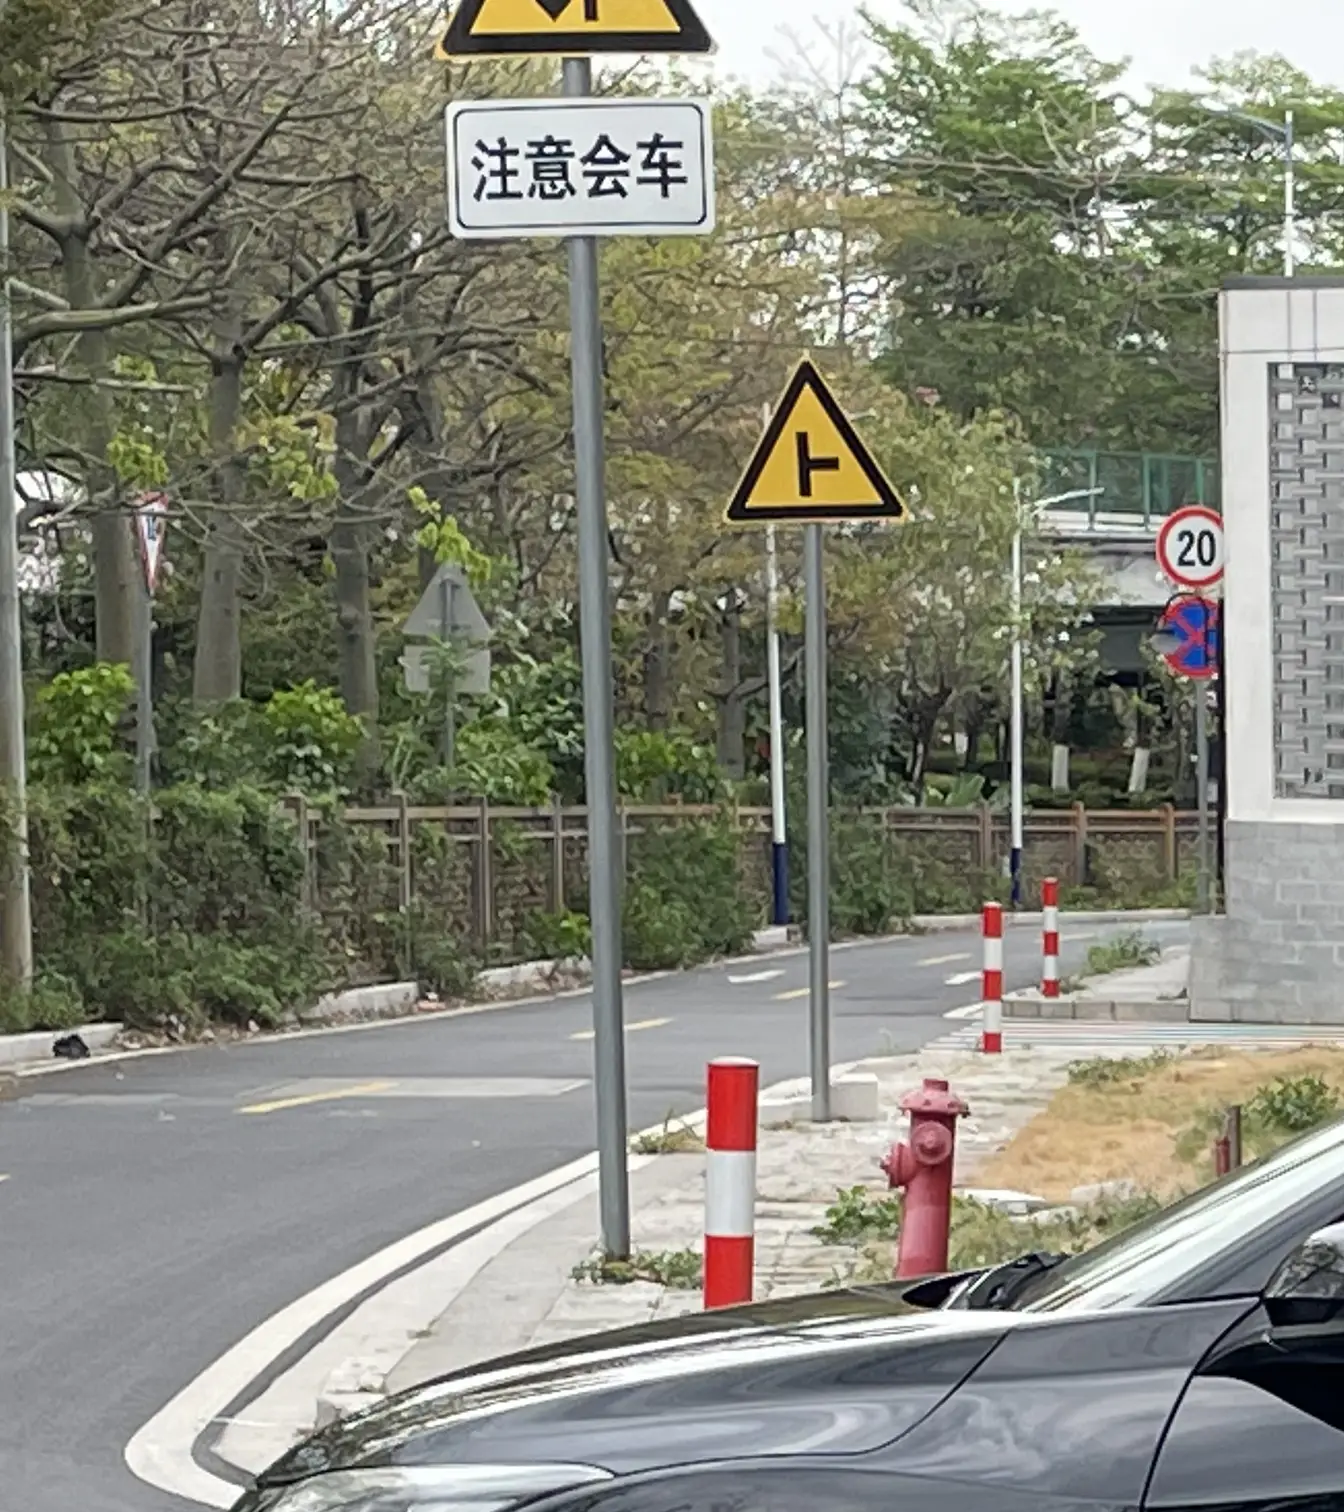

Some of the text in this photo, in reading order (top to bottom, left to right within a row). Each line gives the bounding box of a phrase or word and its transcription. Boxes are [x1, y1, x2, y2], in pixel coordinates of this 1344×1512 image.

[470, 132, 688, 202] 注意会车
[1176, 529, 1217, 567] 20
